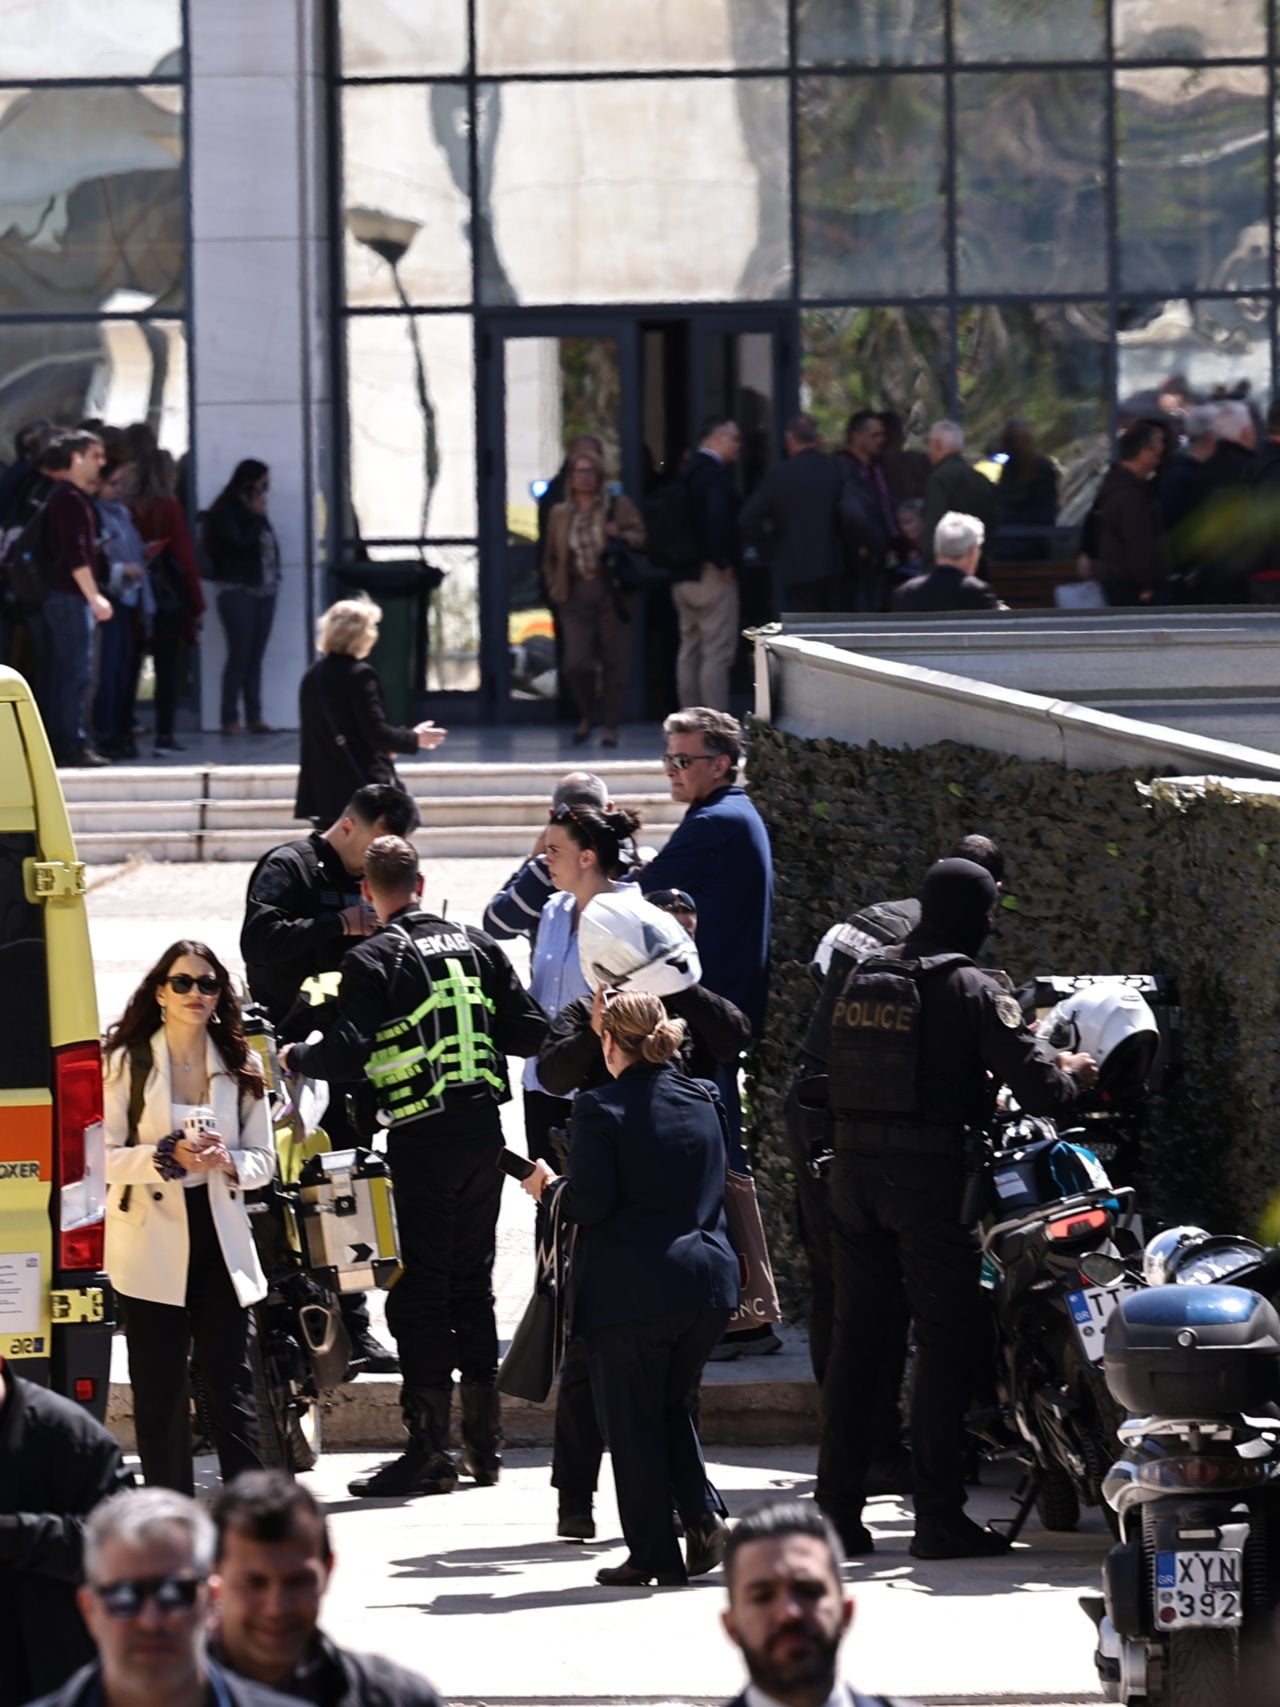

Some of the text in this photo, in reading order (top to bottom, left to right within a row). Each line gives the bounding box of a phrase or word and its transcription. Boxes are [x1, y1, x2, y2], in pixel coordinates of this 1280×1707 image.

[832, 1000, 913, 1031] POLICE
[1178, 1557, 1236, 1583] XYN
[1179, 1593, 1237, 1618] 392
